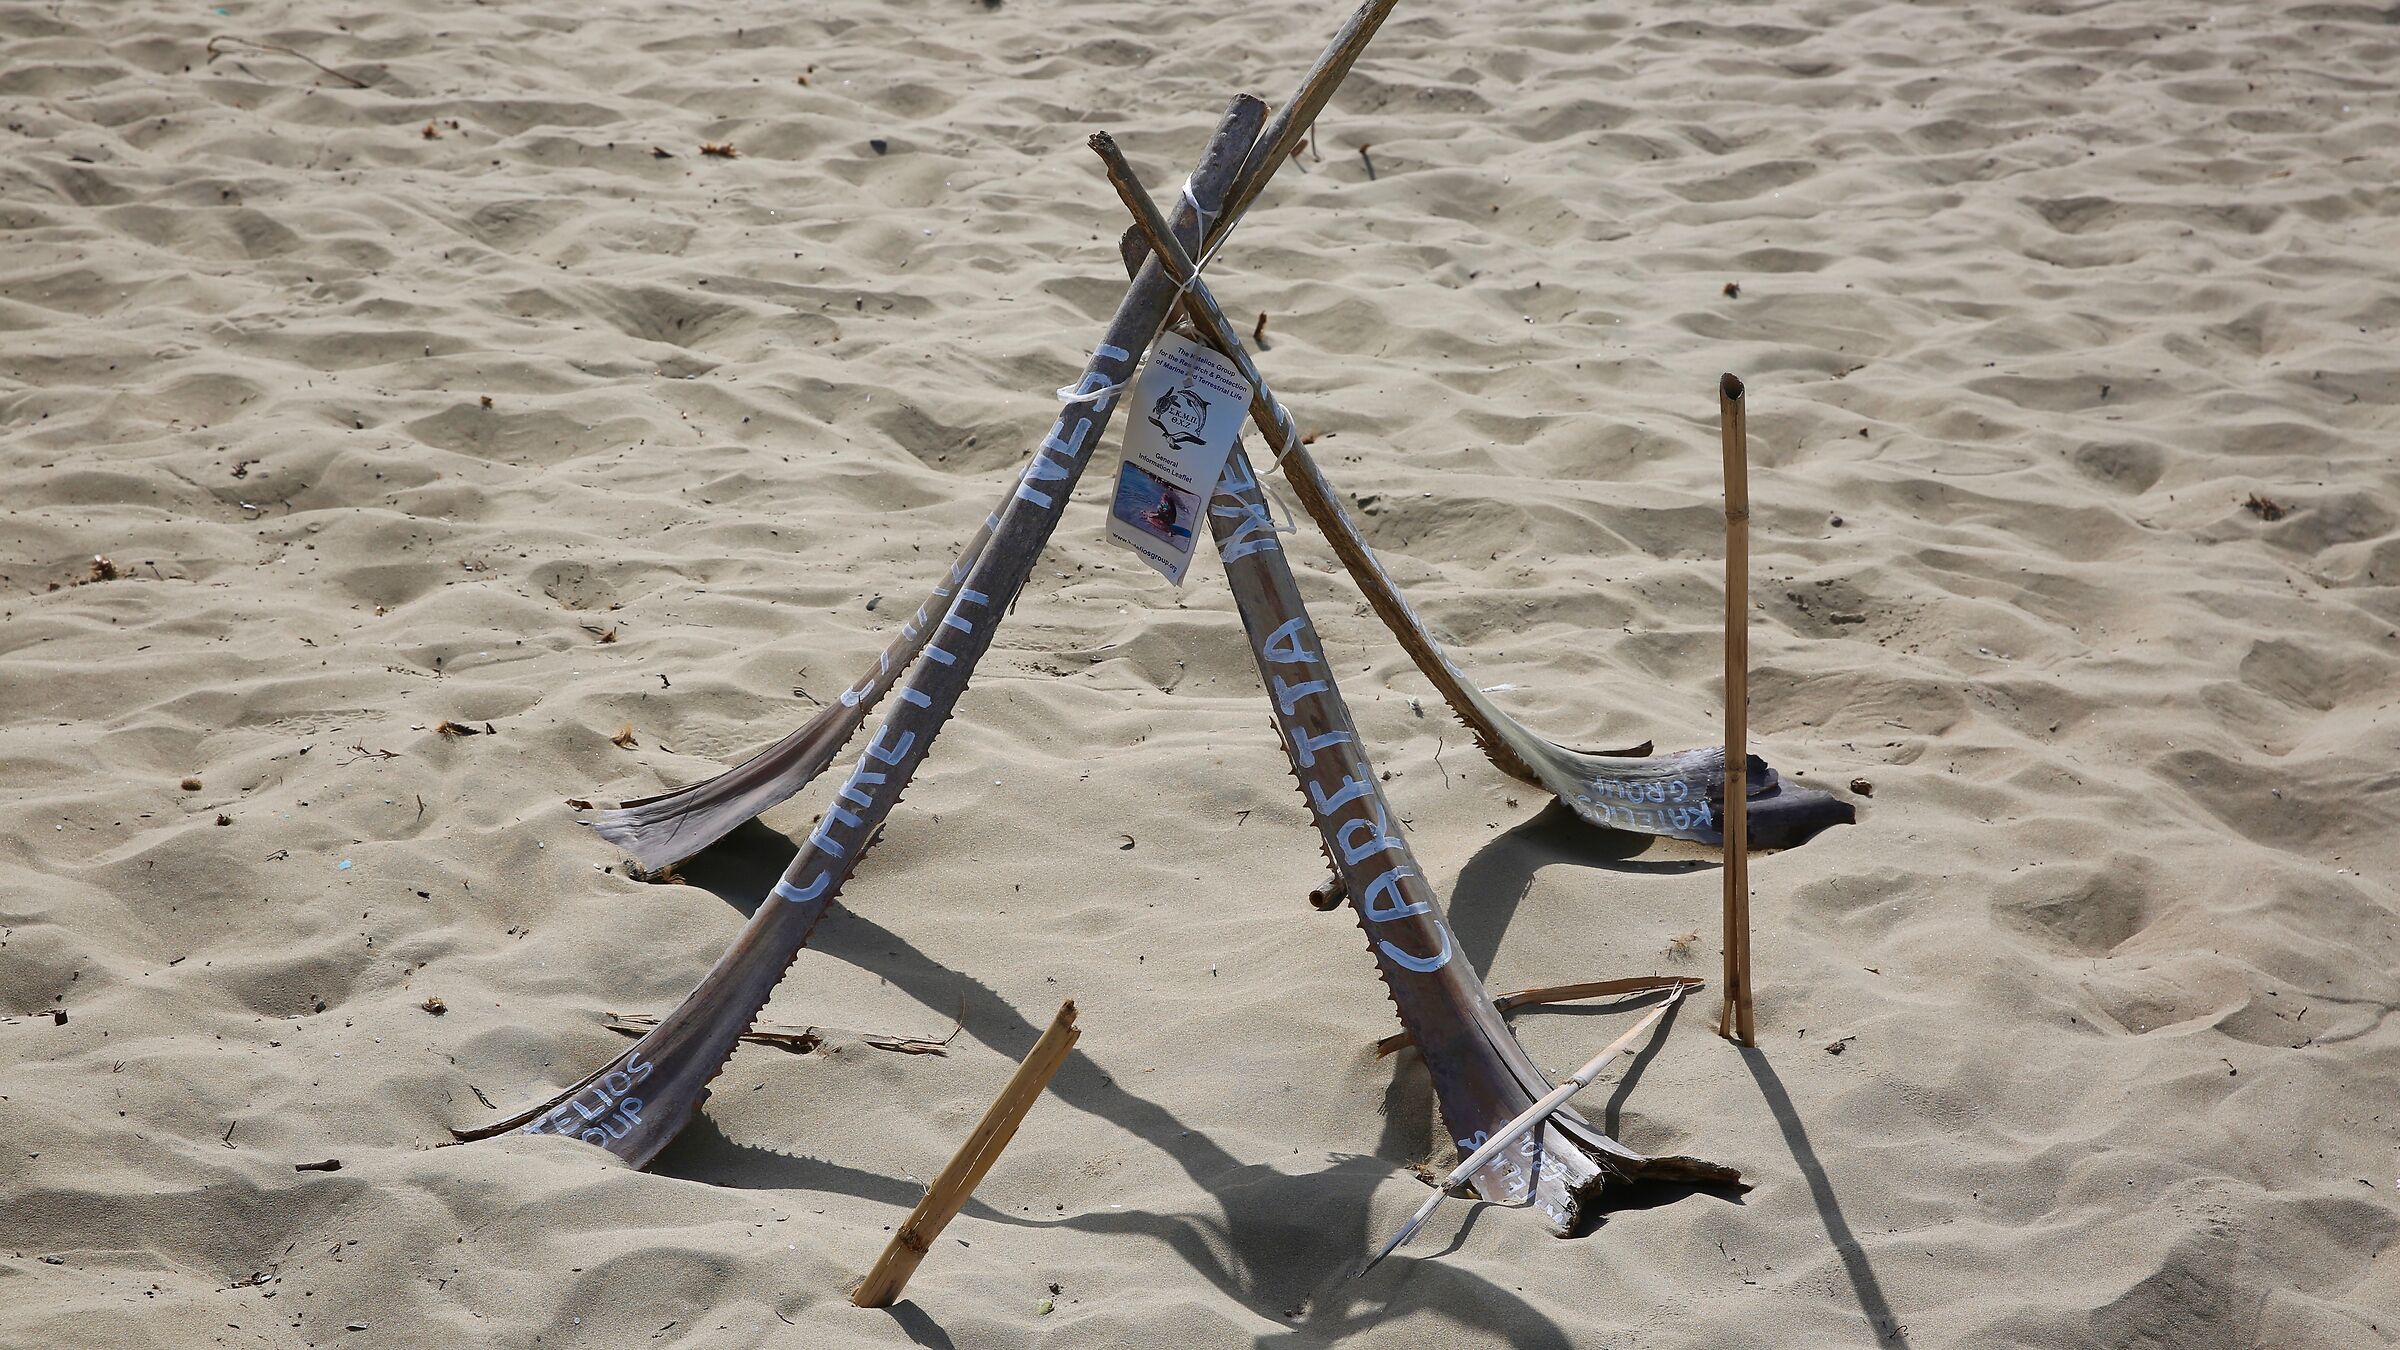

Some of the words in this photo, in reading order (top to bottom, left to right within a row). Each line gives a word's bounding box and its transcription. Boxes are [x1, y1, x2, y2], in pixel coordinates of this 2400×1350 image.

[1159, 348, 1168, 357] for
[1168, 353, 1178, 362] the
[1179, 359, 1208, 375] Resarch
[1215, 374, 1247, 392] Protection
[1178, 347, 1189, 357] The
[1191, 353, 1215, 368] Ktelios
[1216, 364, 1236, 377] Group
[1163, 362, 1185, 375] Marine
[1199, 377, 1230, 395] Terrestrial
[1230, 390, 1243, 401] Life
[1138, 452, 1171, 477] Information
[1171, 468, 1193, 484] Leaflet
[1155, 452, 1179, 469] General
[1263, 615, 1453, 973] CARETTA
